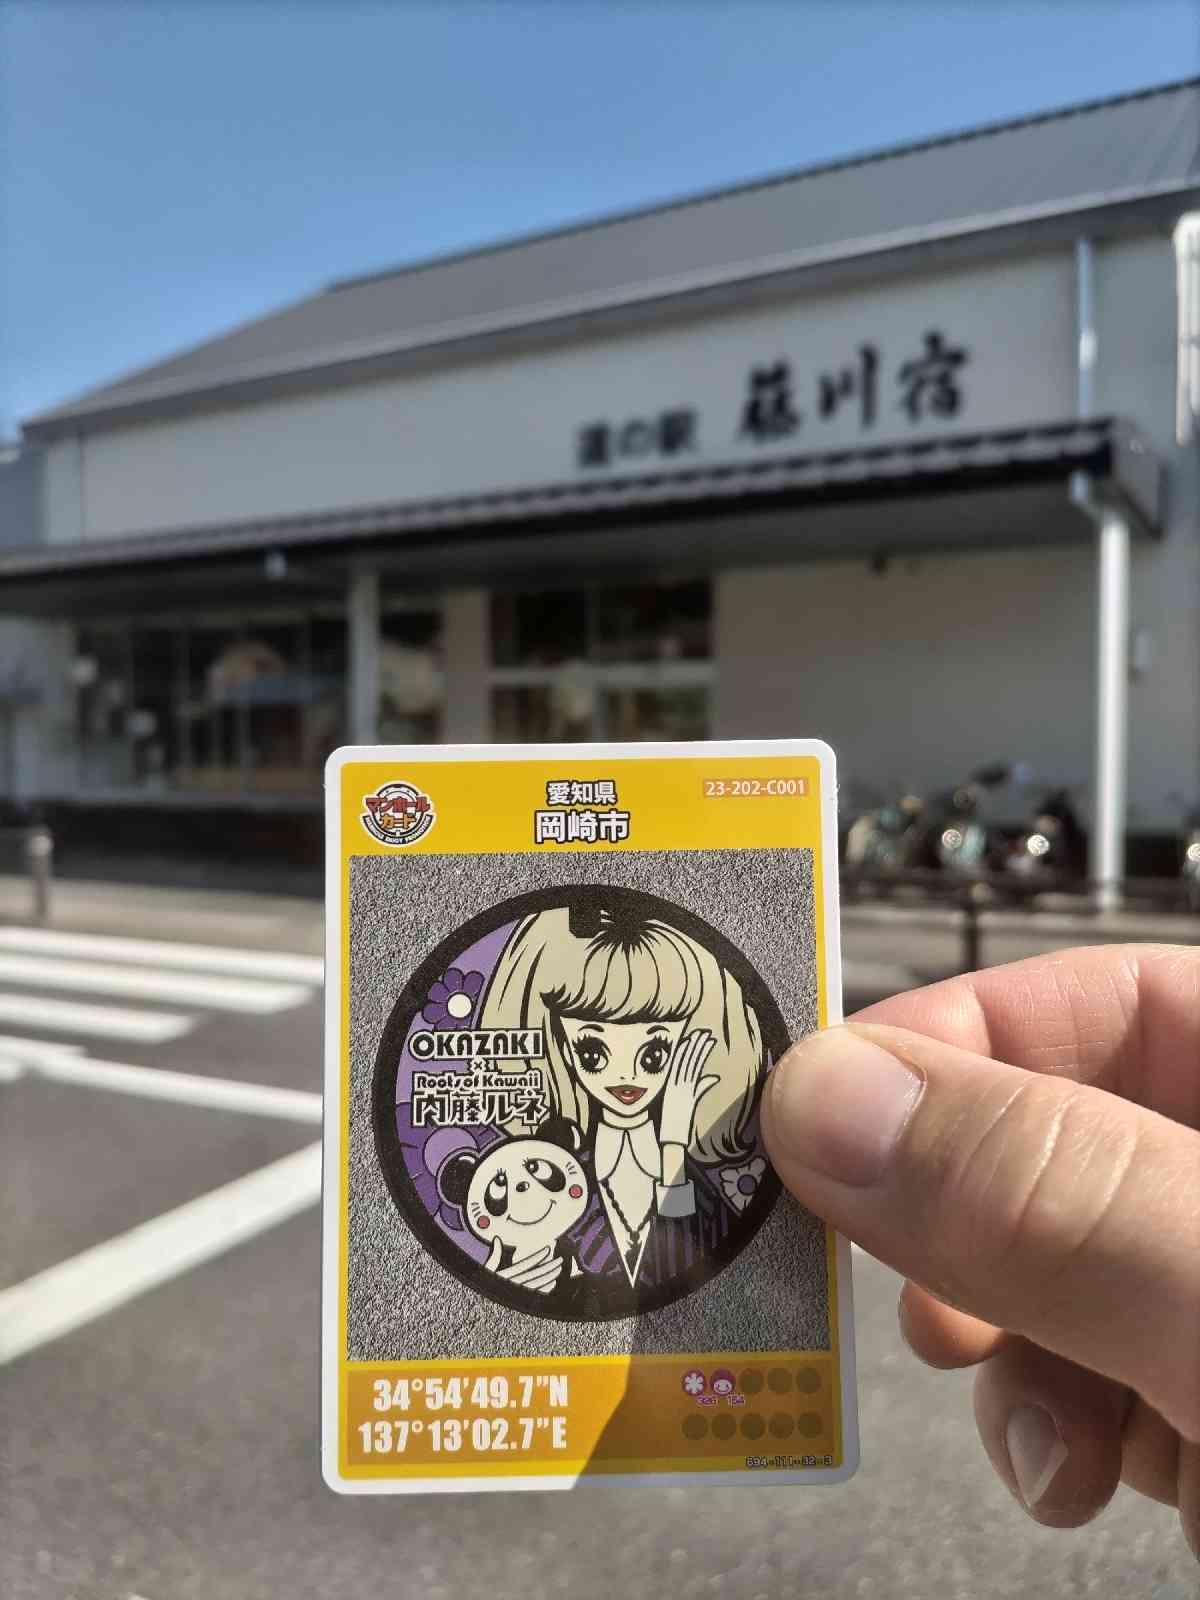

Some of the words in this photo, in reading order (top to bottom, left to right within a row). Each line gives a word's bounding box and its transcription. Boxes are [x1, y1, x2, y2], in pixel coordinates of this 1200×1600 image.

[547, 780, 617, 805] 愛知県
[705, 779, 806, 797] 23-202-C001
[535, 809, 630, 843] 岡崎市
[411, 1031, 542, 1058] OKAZAKI
[482, 1073, 540, 1089] Kawaii
[414, 1089, 544, 1124] 内藤ルネ
